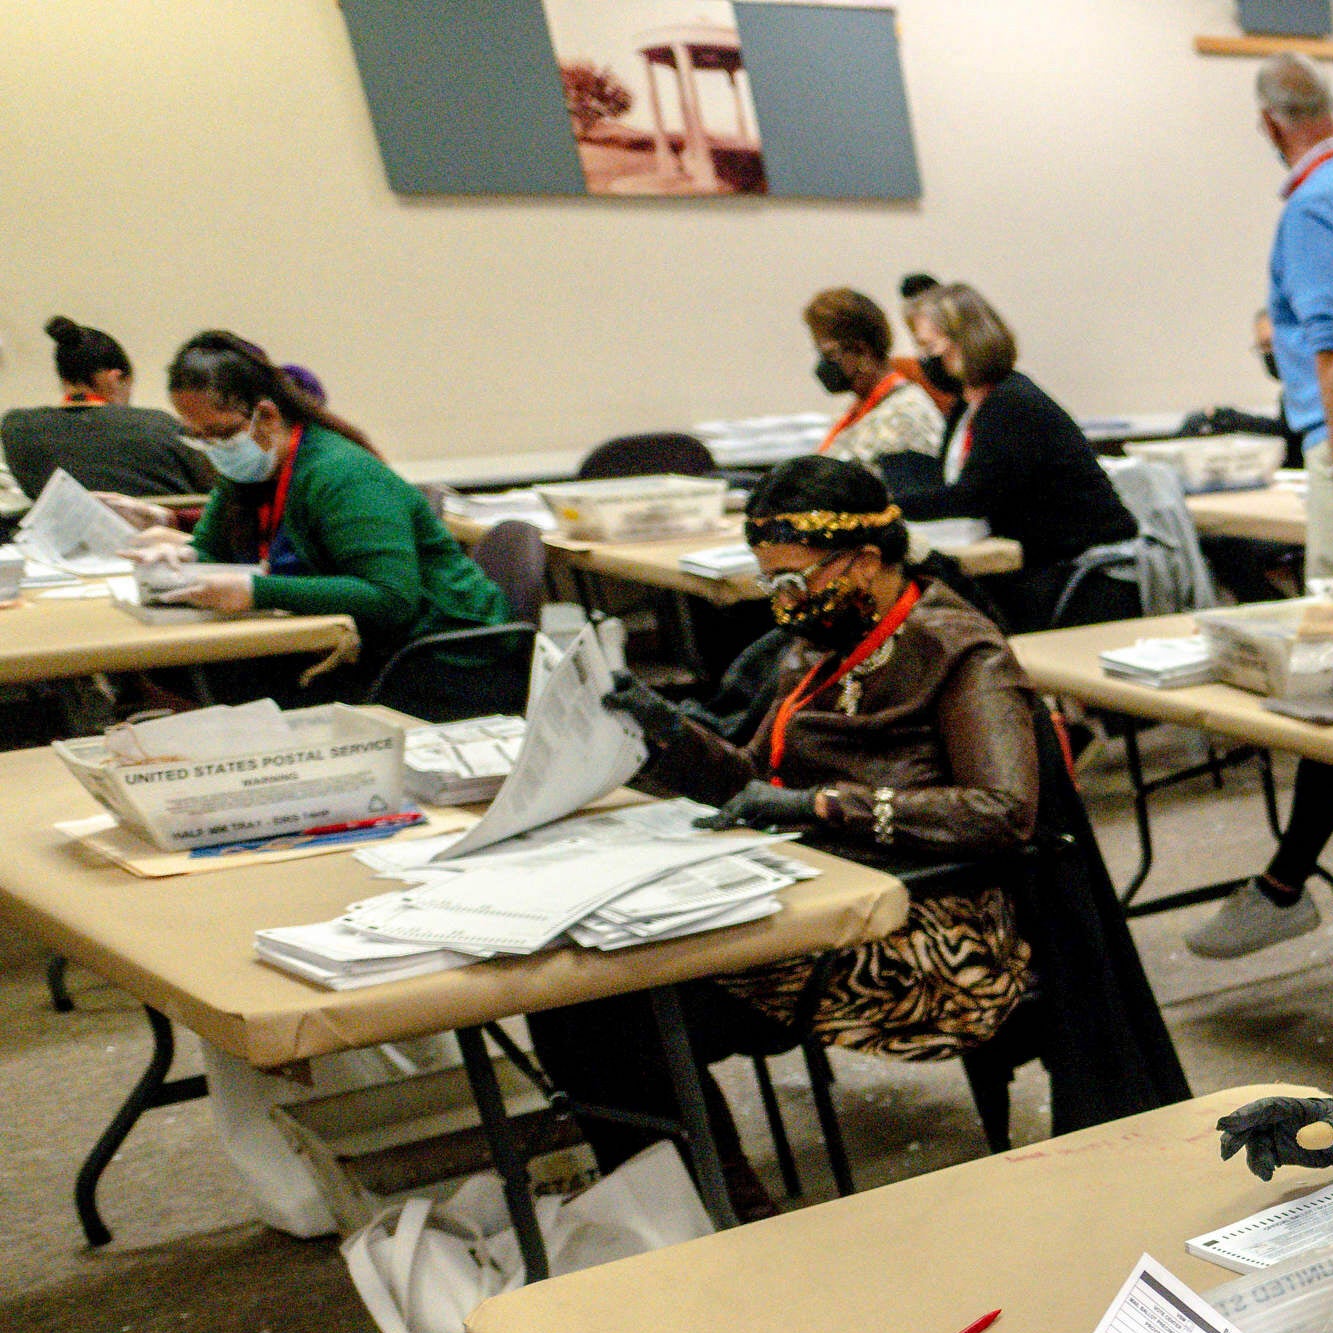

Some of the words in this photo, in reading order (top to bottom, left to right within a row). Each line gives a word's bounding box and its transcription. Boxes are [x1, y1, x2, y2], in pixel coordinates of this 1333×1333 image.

[125, 767, 189, 786] UNITED
[194, 760, 259, 779] STATES
[262, 749, 325, 769] POSTAL
[329, 737, 394, 758] SERVICE
[241, 771, 299, 787] WARNING
